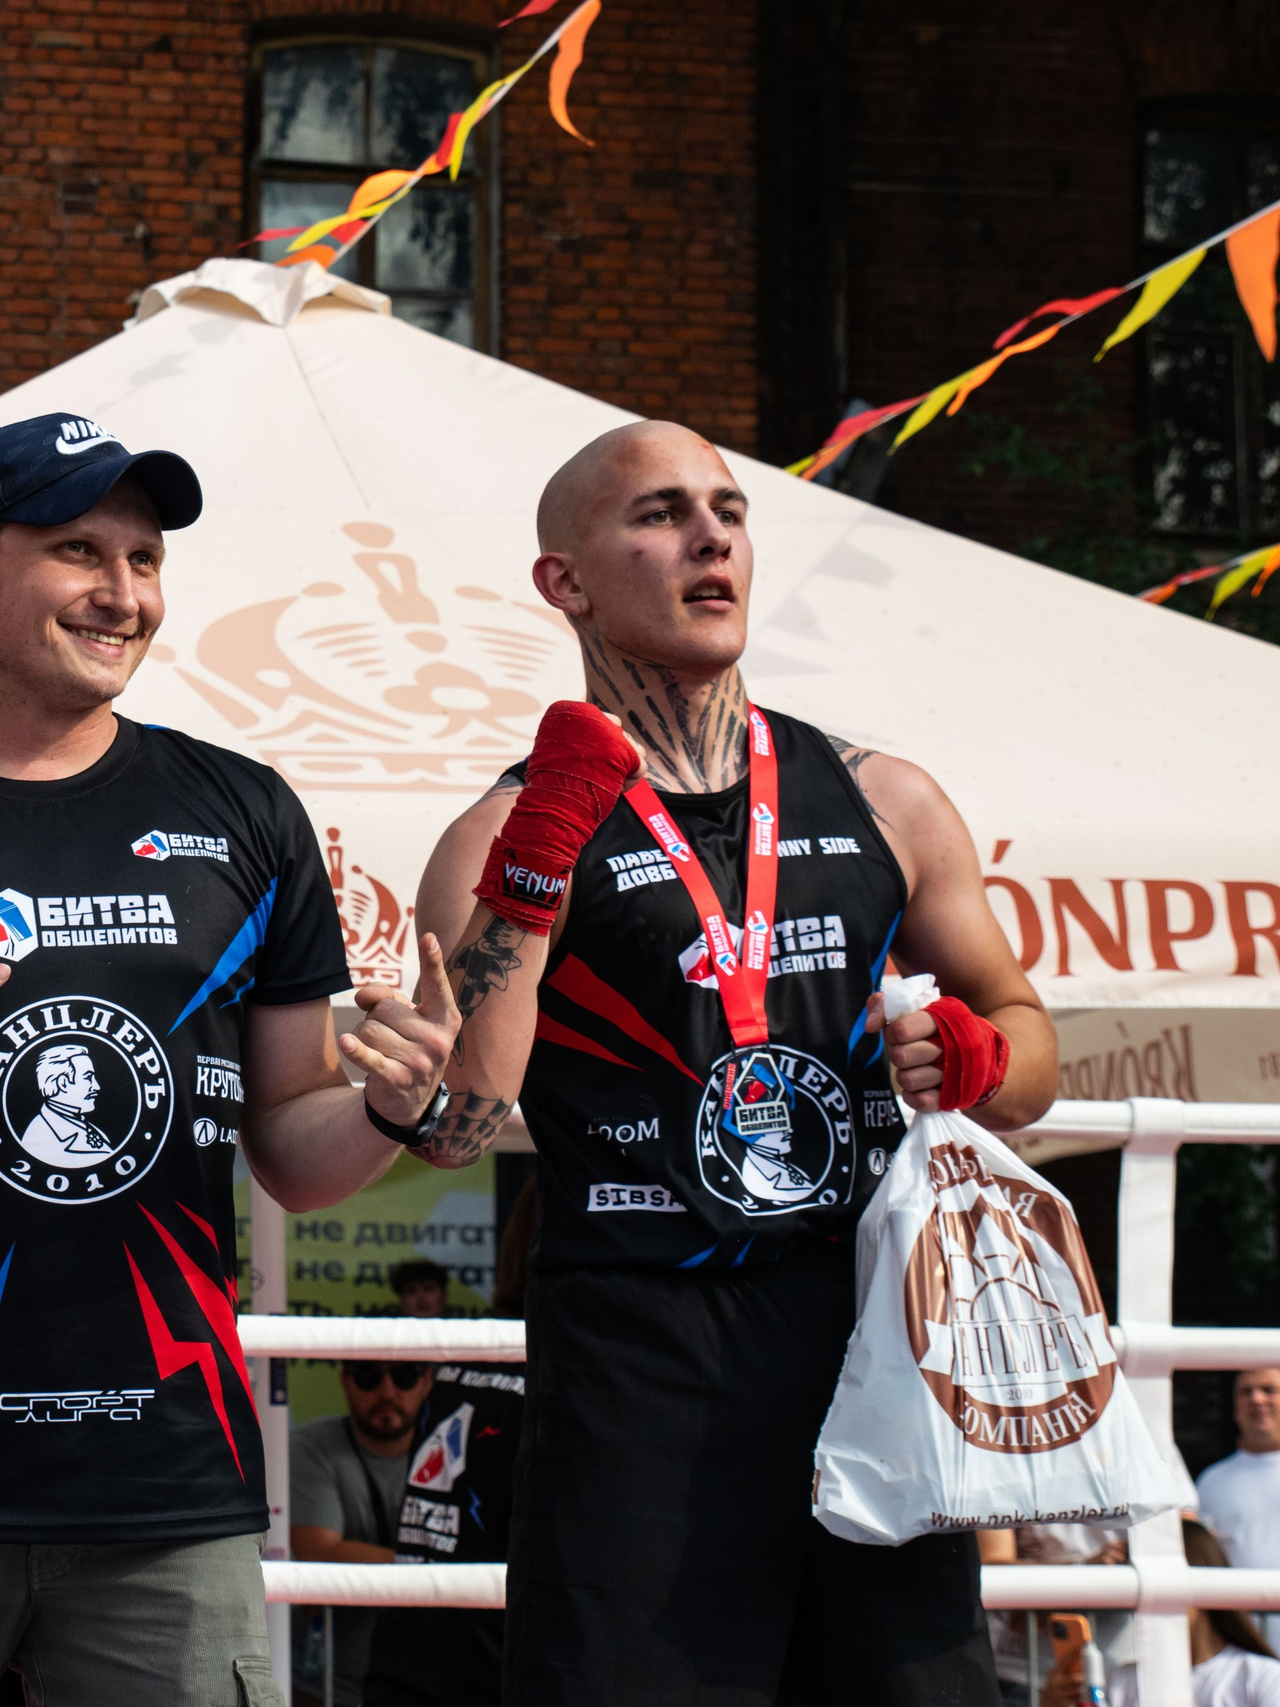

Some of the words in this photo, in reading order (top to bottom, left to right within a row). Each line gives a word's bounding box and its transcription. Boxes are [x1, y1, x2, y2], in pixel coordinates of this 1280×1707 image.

[60, 420, 116, 440] NIK
[168, 833, 229, 853] БИТВА
[777, 839, 812, 857] NNY
[818, 837, 862, 855] SIDE
[606, 849, 672, 872] ПАВЕ
[505, 862, 566, 895] VENUM
[616, 863, 680, 892] ДОВБ
[37, 894, 176, 927] БИТВА
[41, 926, 178, 948] ОБЩЕПИТОВ
[771, 915, 847, 956] ТВА
[767, 951, 847, 979] ЩЕПИТОВ
[739, 1105, 786, 1122] БИТВА
[10, 1154, 137, 1193] 2010
[294, 1220, 345, 1242] не
[294, 1260, 345, 1282] не
[957, 1320, 1089, 1379] АНЦЛЕРЪ
[959, 1390, 1097, 1447] ОМПАНИЯ
